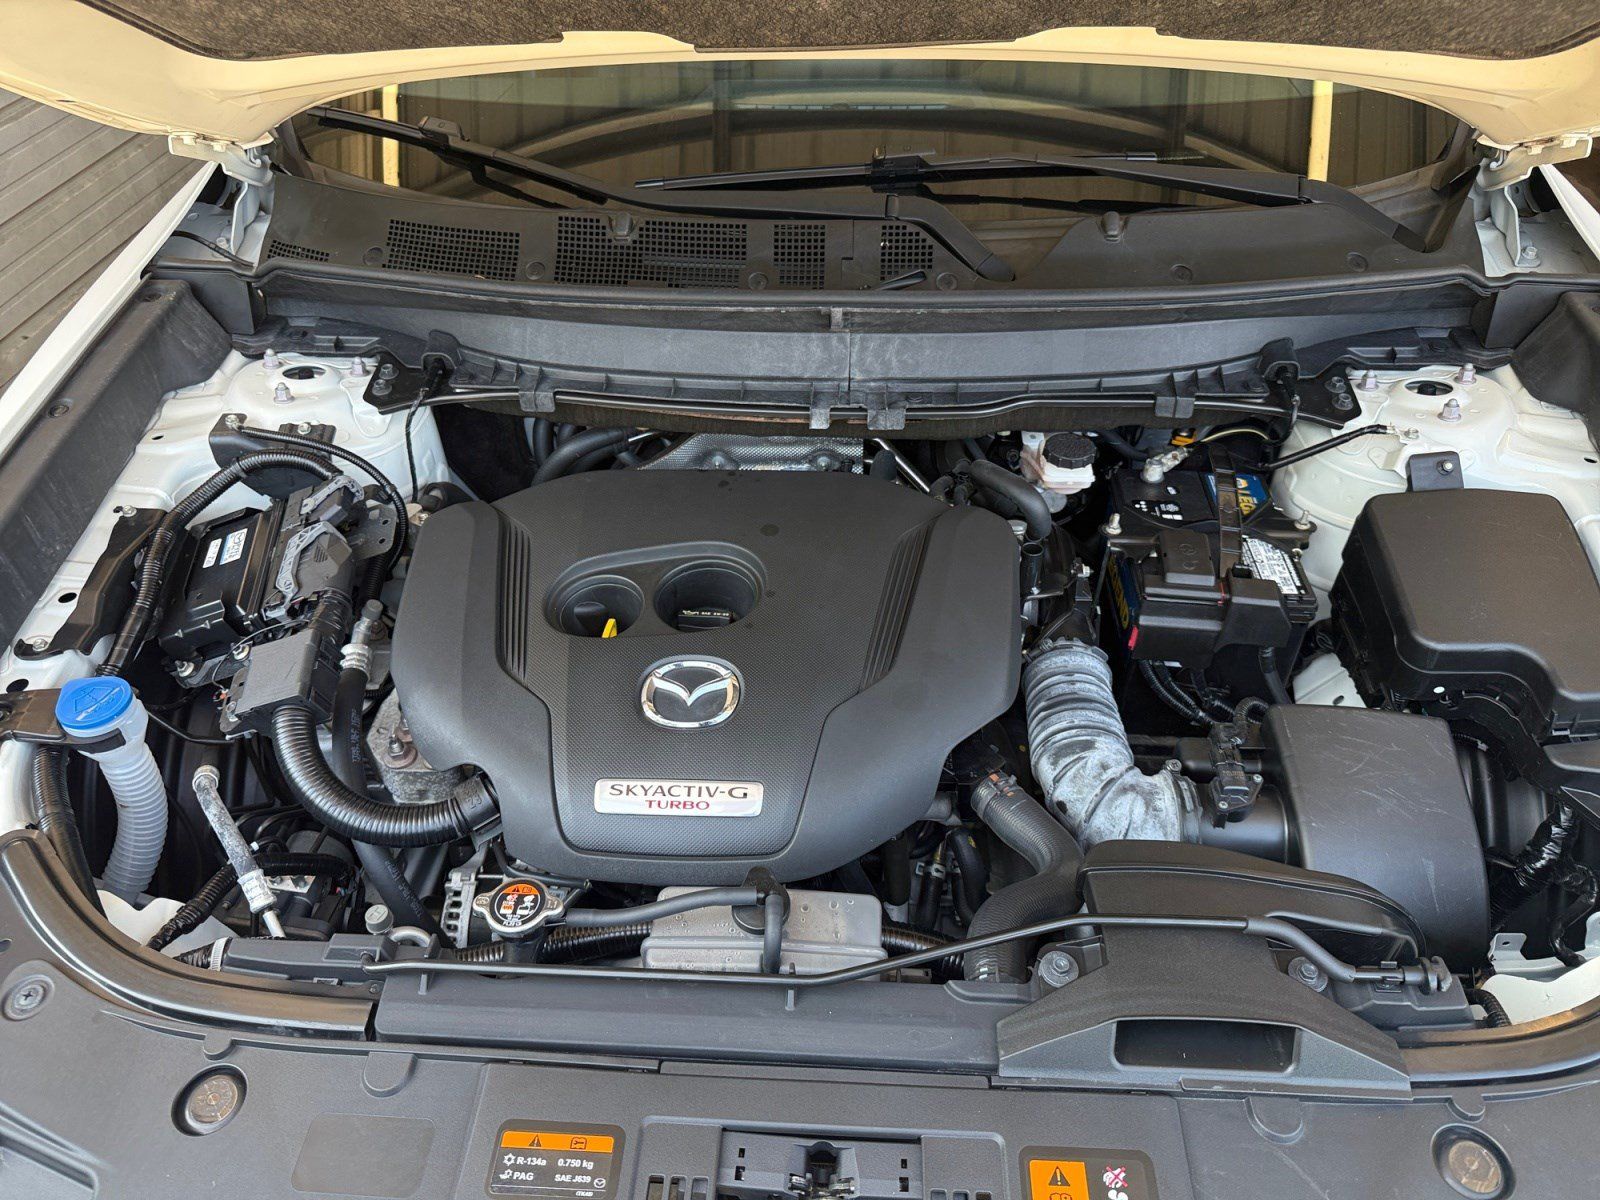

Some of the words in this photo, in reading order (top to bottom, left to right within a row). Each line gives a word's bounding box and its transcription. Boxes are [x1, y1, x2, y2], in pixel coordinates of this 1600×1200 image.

[609, 783, 749, 799] SKYACTIV-G
[645, 800, 710, 810] TURBO
[516, 1156, 547, 1166] R-134a
[557, 1158, 581, 1168] 0.750
[582, 1159, 594, 1170] kg
[513, 1171, 534, 1181] PAG
[554, 1173, 572, 1183] SAE
[572, 1175, 592, 1184] J639
